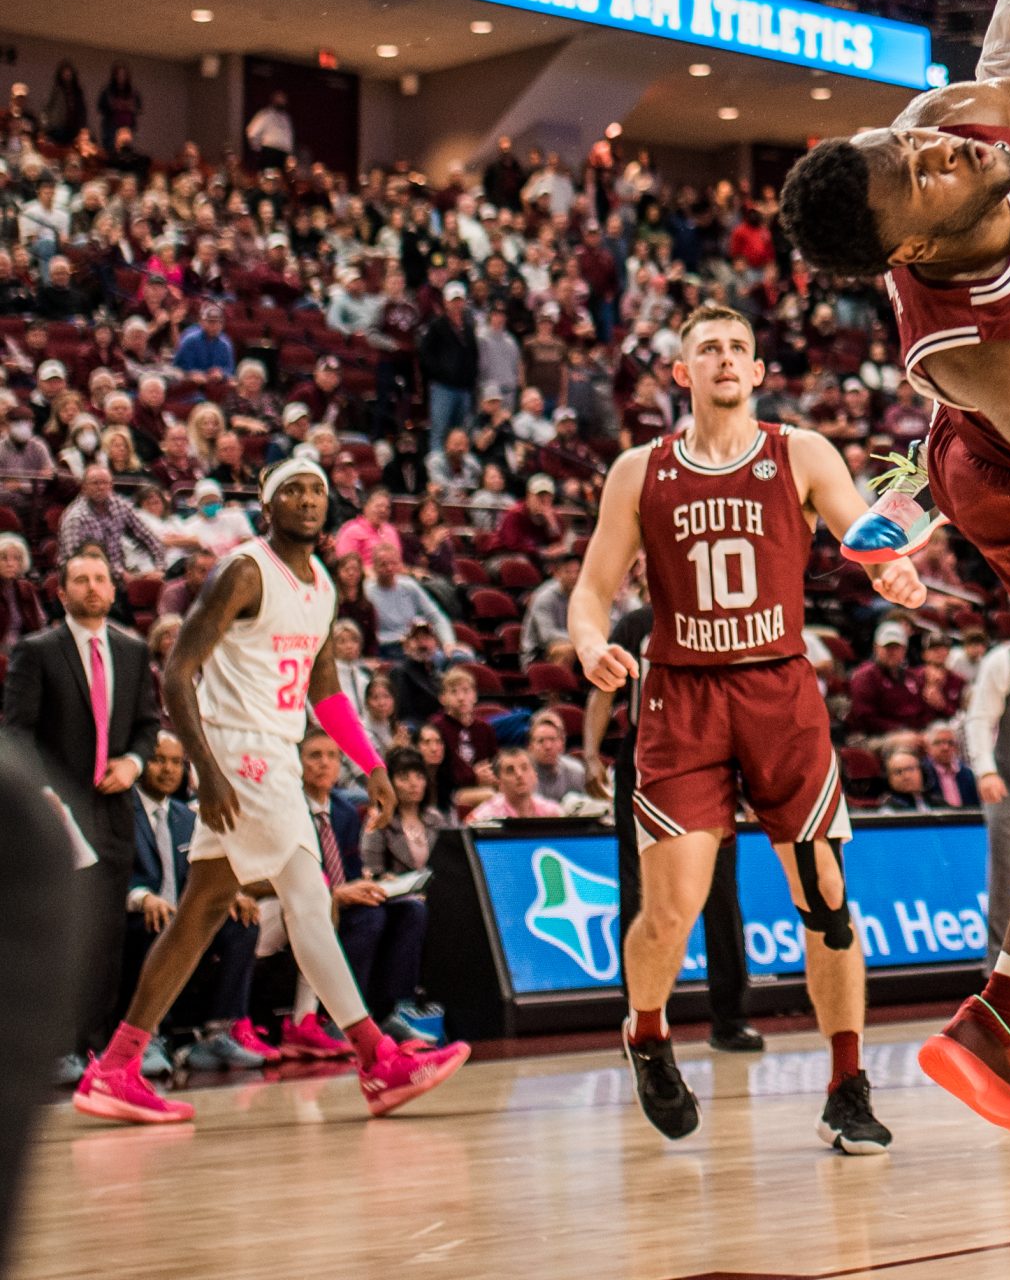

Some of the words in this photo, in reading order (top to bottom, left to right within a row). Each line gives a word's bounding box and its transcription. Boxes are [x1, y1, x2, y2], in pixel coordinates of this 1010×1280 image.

[673, 498, 764, 542] SOUTH
[686, 537, 758, 612] 10
[674, 603, 785, 653] CAROLINA
